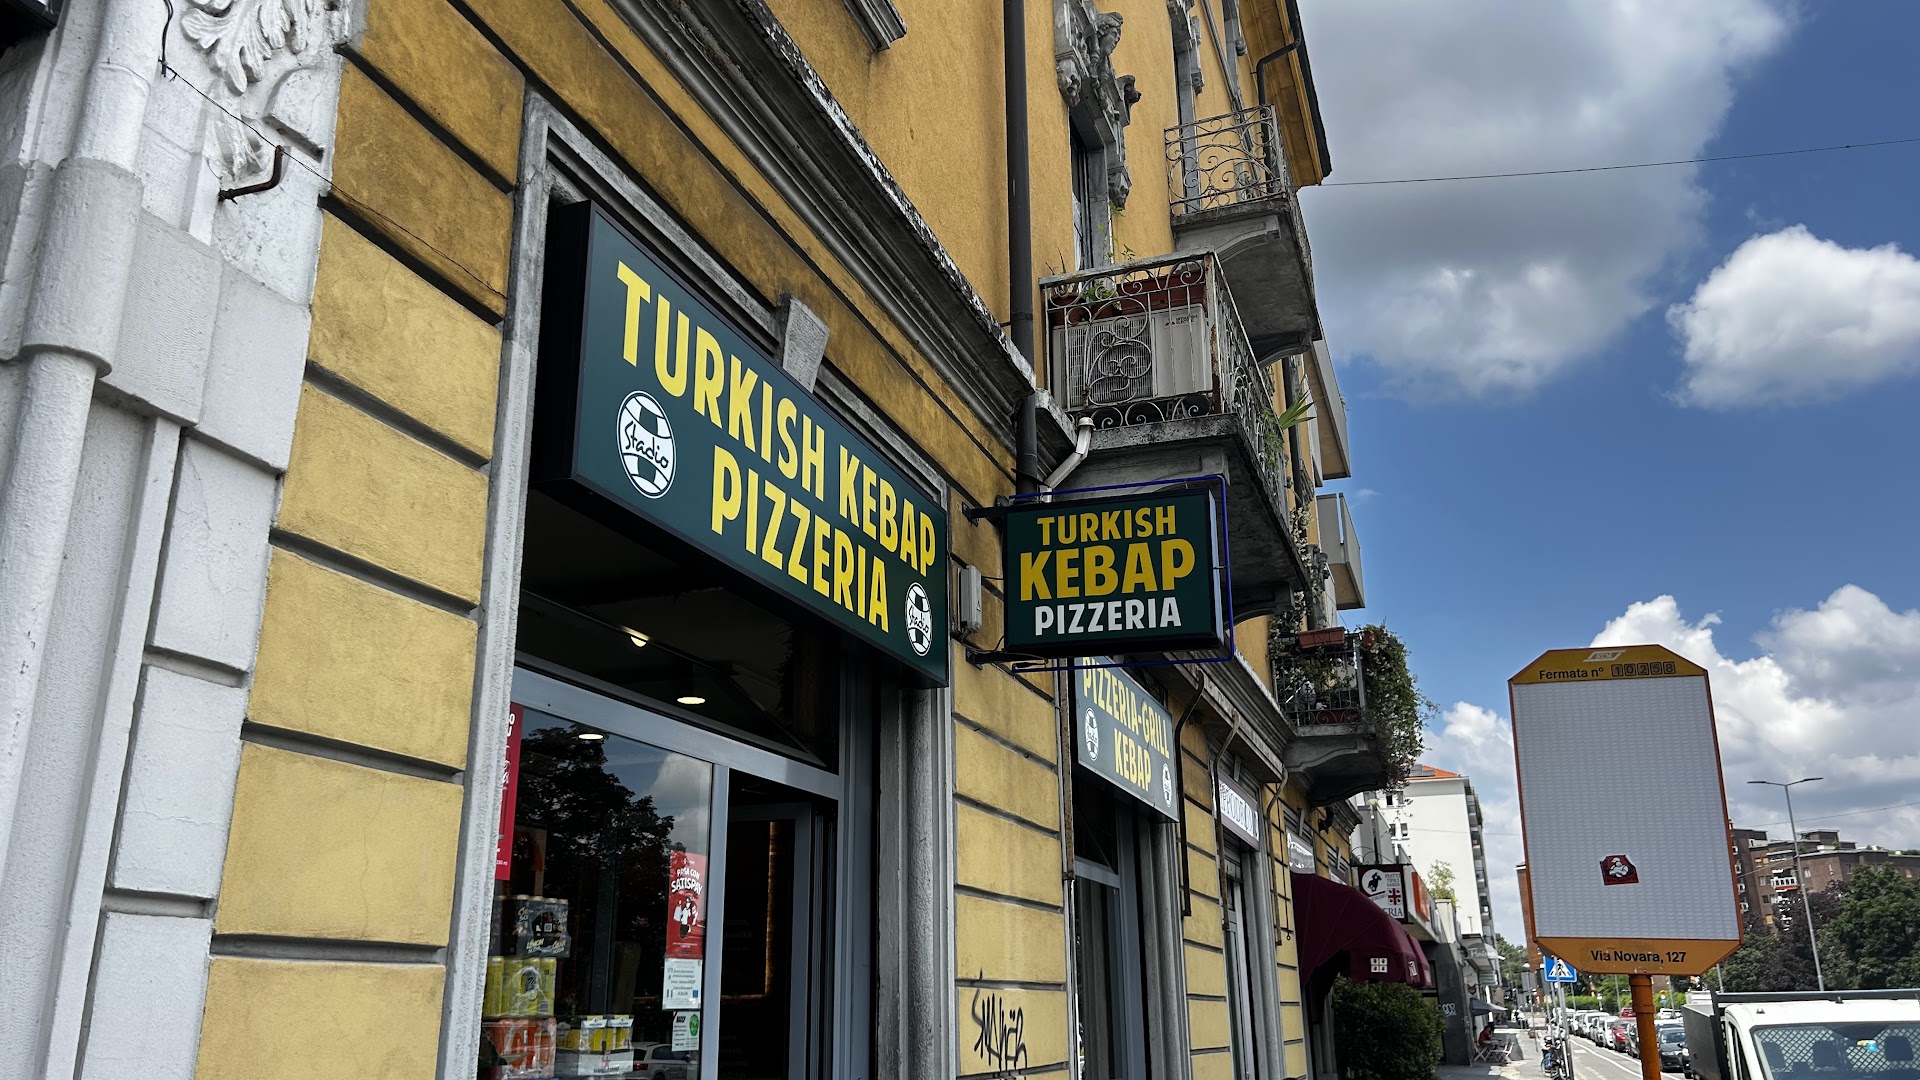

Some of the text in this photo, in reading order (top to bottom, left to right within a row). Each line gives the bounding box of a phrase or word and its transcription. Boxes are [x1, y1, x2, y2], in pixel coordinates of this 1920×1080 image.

[616, 260, 937, 578] TURKISH KEBAP
[624, 420, 670, 469] Stadio
[711, 445, 890, 633] PIZZERIA
[1037, 505, 1176, 546] TURKISH
[1020, 538, 1196, 602] KEBAP
[1035, 596, 1182, 636] PIZZERIA
[1538, 668, 1588, 680] Fermata
[1611, 661, 1675, 677] 10258
[1082, 657, 1170, 760] PIZZERIA-GRILL
[1113, 727, 1152, 793] KEBAP
[671, 877, 703, 895] SATISPAY
[1590, 950, 1687, 964] Via Novara, 127
